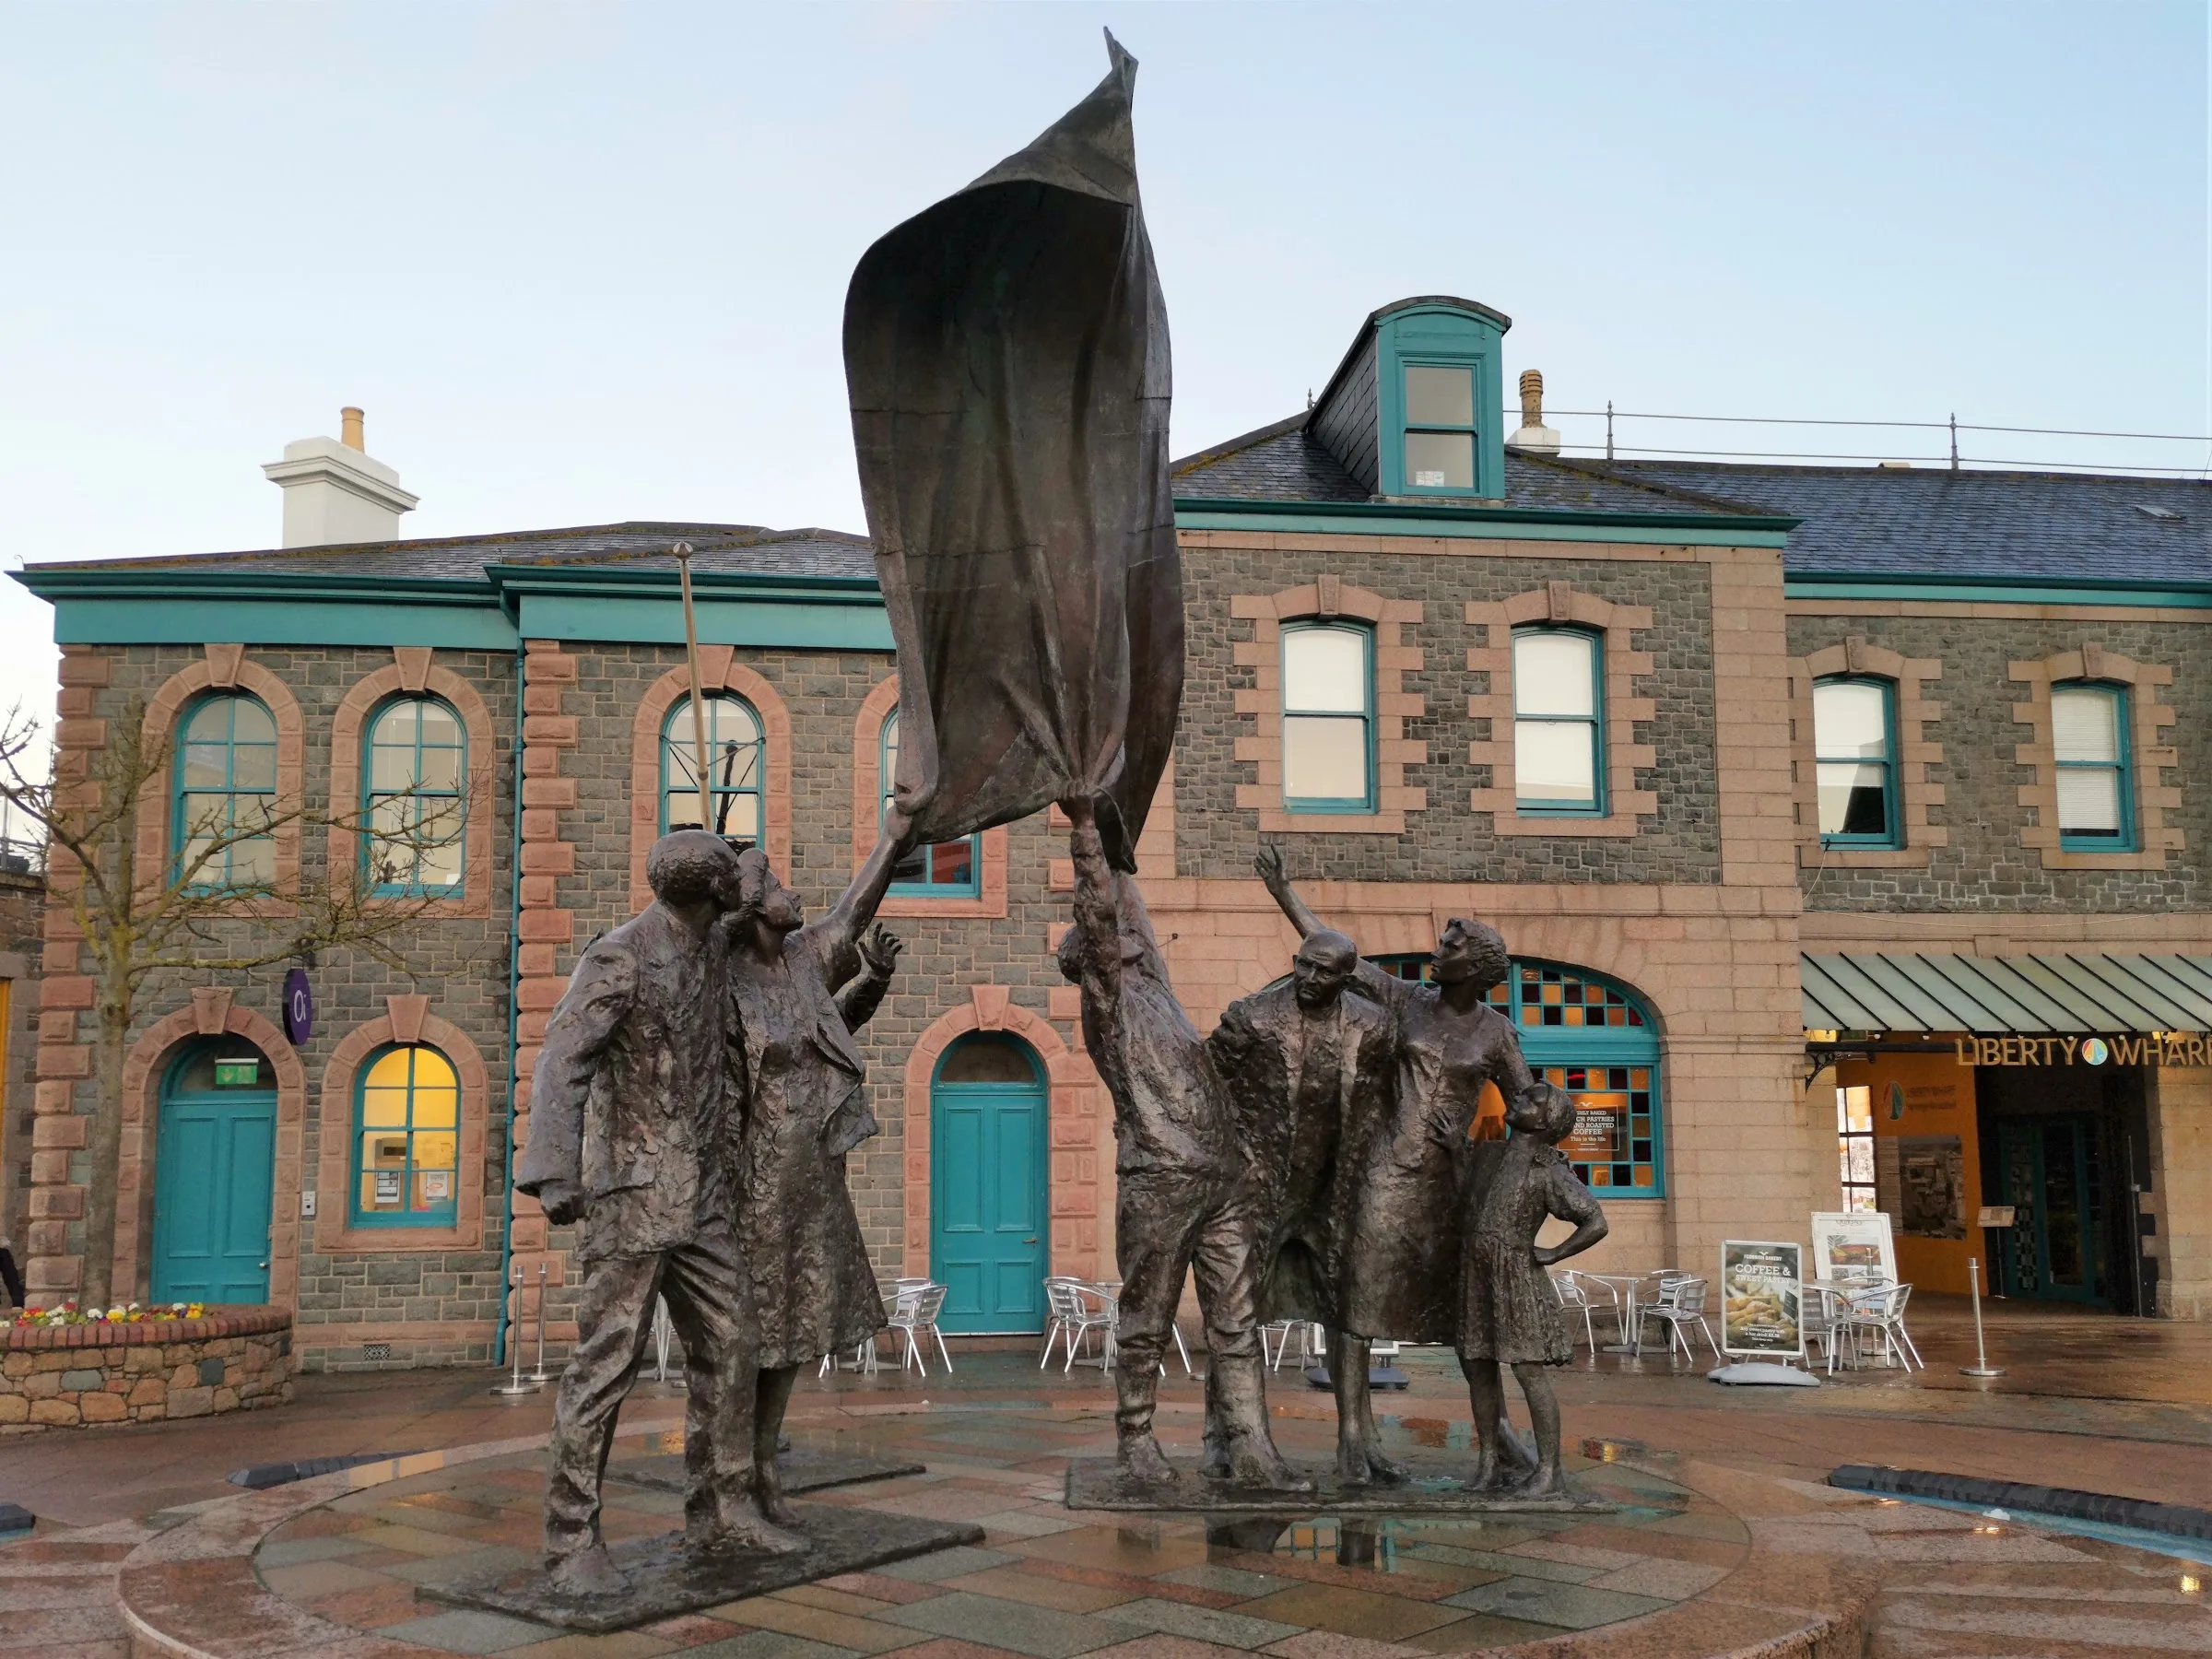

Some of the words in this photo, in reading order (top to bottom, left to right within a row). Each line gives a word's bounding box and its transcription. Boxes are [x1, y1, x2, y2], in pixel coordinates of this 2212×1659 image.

[1955, 1038, 2078, 1065] LIBERTY
[1735, 1264, 1780, 1276] COFFEE
[1783, 1266, 1791, 1276] &
